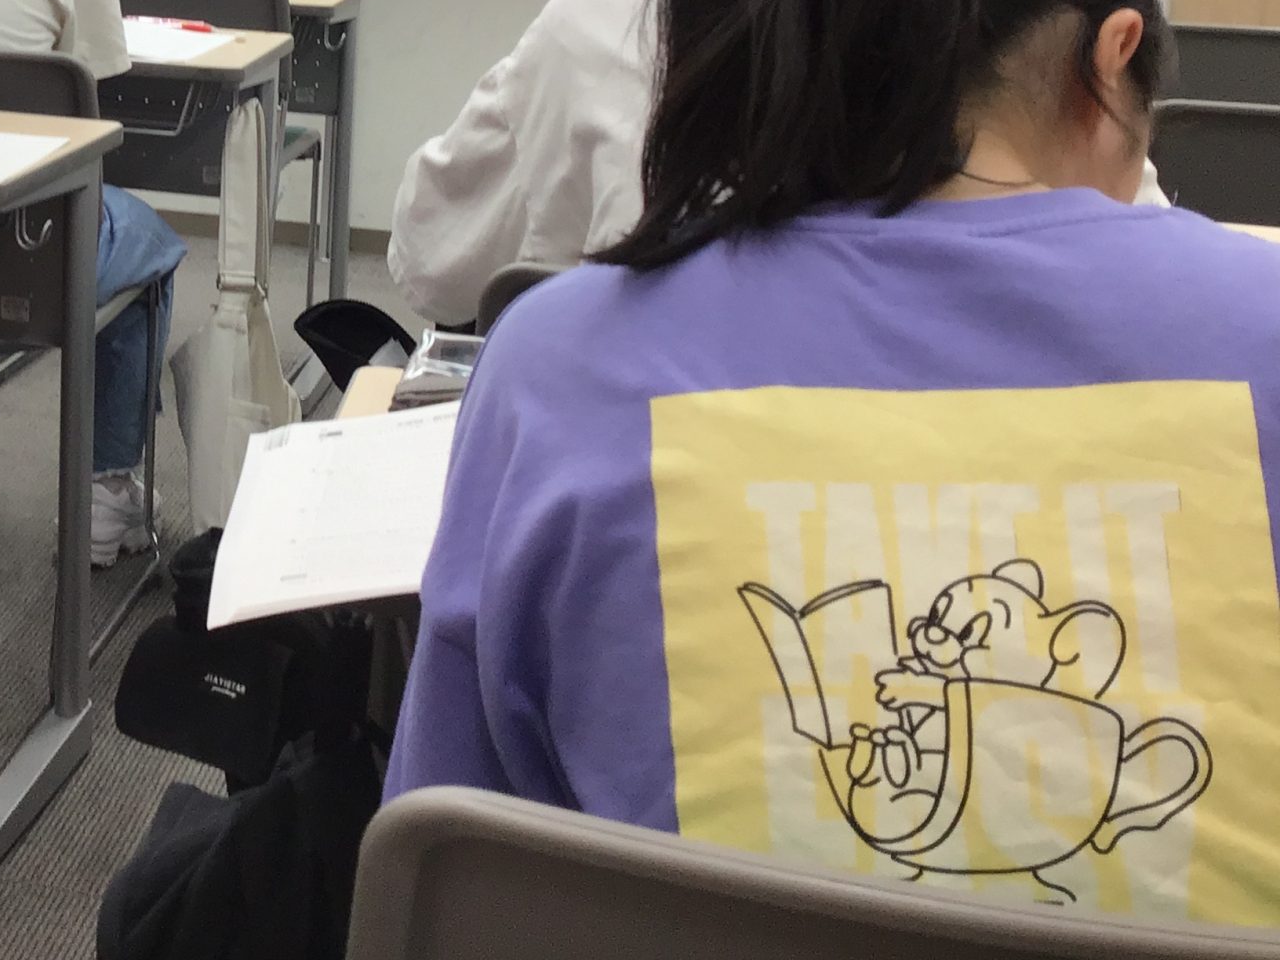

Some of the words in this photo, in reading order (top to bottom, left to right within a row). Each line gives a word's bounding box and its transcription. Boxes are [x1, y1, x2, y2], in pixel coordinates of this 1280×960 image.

[745, 480, 1058, 690] TAKE
[1062, 480, 1183, 696] IT
[760, 692, 1206, 920] EASY
